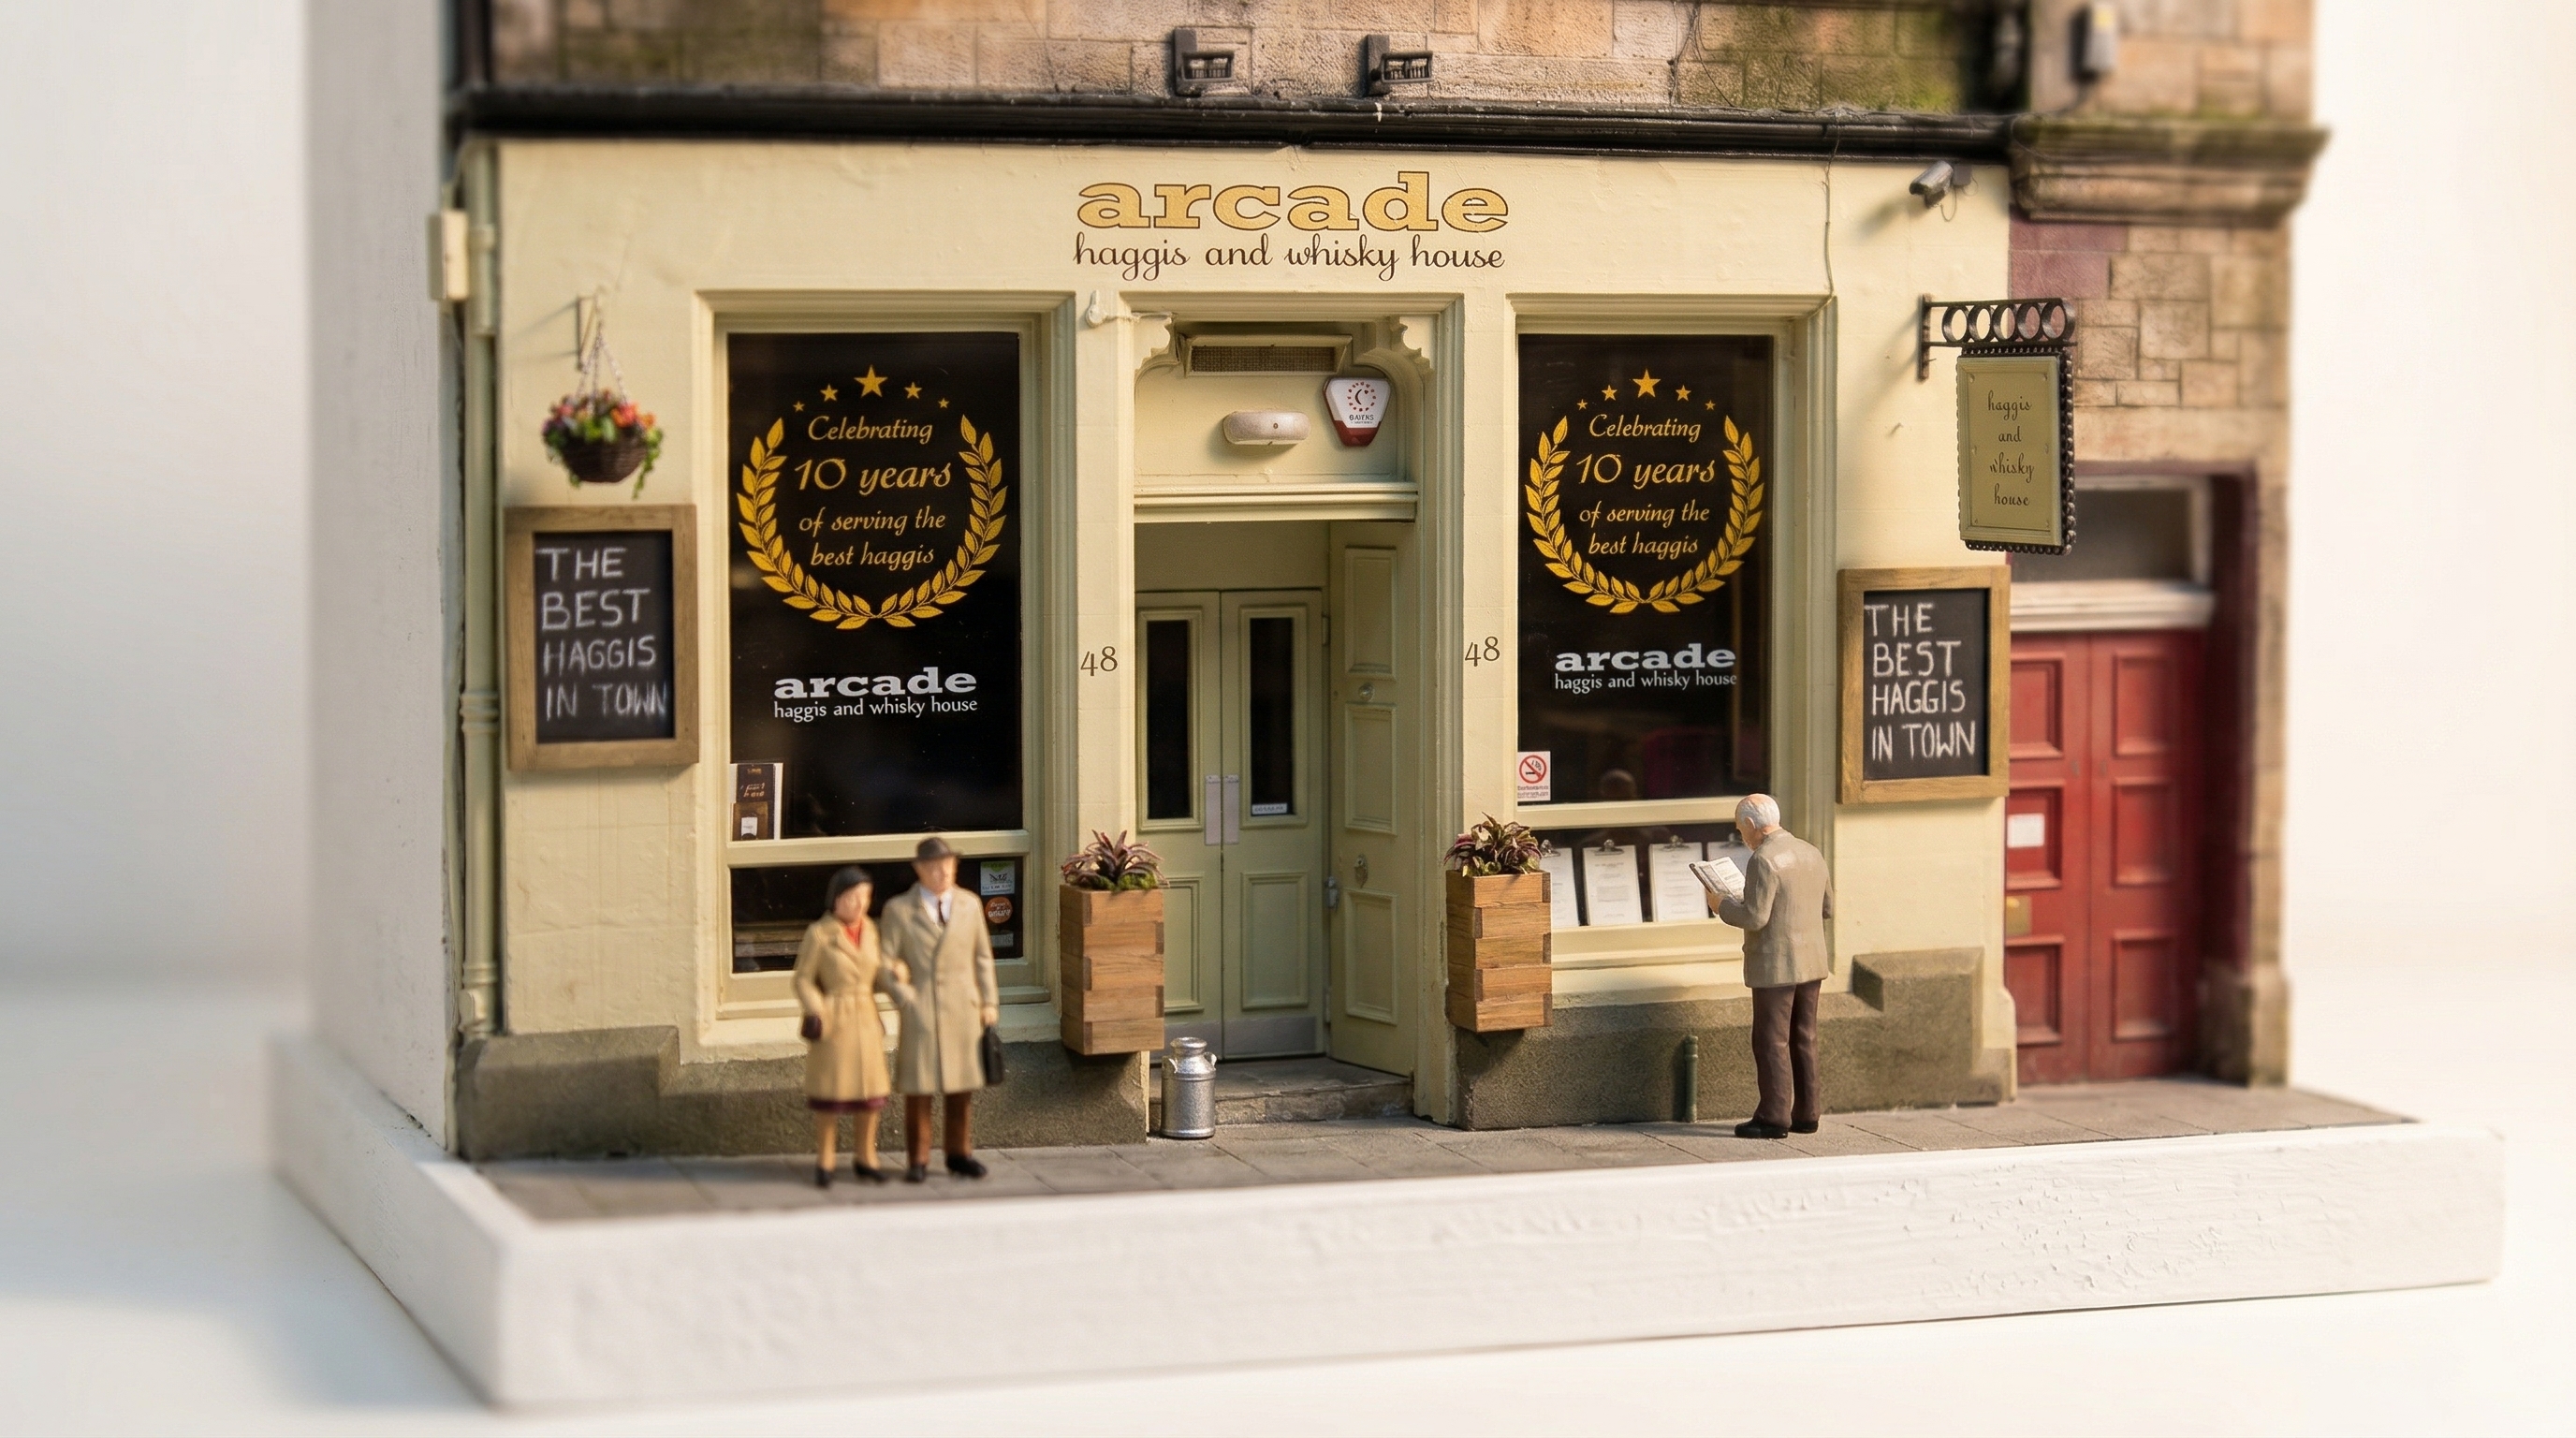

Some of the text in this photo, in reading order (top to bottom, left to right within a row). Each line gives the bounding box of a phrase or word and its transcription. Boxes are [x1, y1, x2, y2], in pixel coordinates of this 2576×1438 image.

[1077, 171, 1508, 232] arcade
[1073, 231, 1505, 281] haggis and whisky house
[1987, 389, 2032, 420] haggis
[808, 416, 933, 444] Celebrating
[1589, 414, 1702, 443] Celebrating
[1998, 425, 2022, 442] and
[795, 458, 952, 495] 10 years
[1576, 453, 1715, 490] 10 years
[1989, 451, 2035, 483] whisky
[1994, 483, 2030, 506] house
[798, 506, 945, 537] of serving the
[1579, 499, 1710, 528] of serving the
[810, 541, 934, 570] best haggis
[1588, 532, 1698, 560] best haggis
[535, 547, 626, 581] THE
[542, 587, 651, 630] BEST
[1864, 602, 1934, 637] THE
[543, 635, 656, 676] HAGGIS
[1080, 646, 1118, 676] 48
[1465, 636, 1500, 667] 48
[1555, 643, 1736, 671] arcade
[1873, 640, 1961, 677] BEST
[774, 667, 976, 698] arcade
[1555, 669, 1737, 694] haggis and whisky house
[547, 681, 667, 721] IN TOWN
[774, 696, 977, 723] haggis and whisky house
[1873, 680, 1966, 715] HAGGIS
[1873, 720, 1976, 762] IN TOWN
